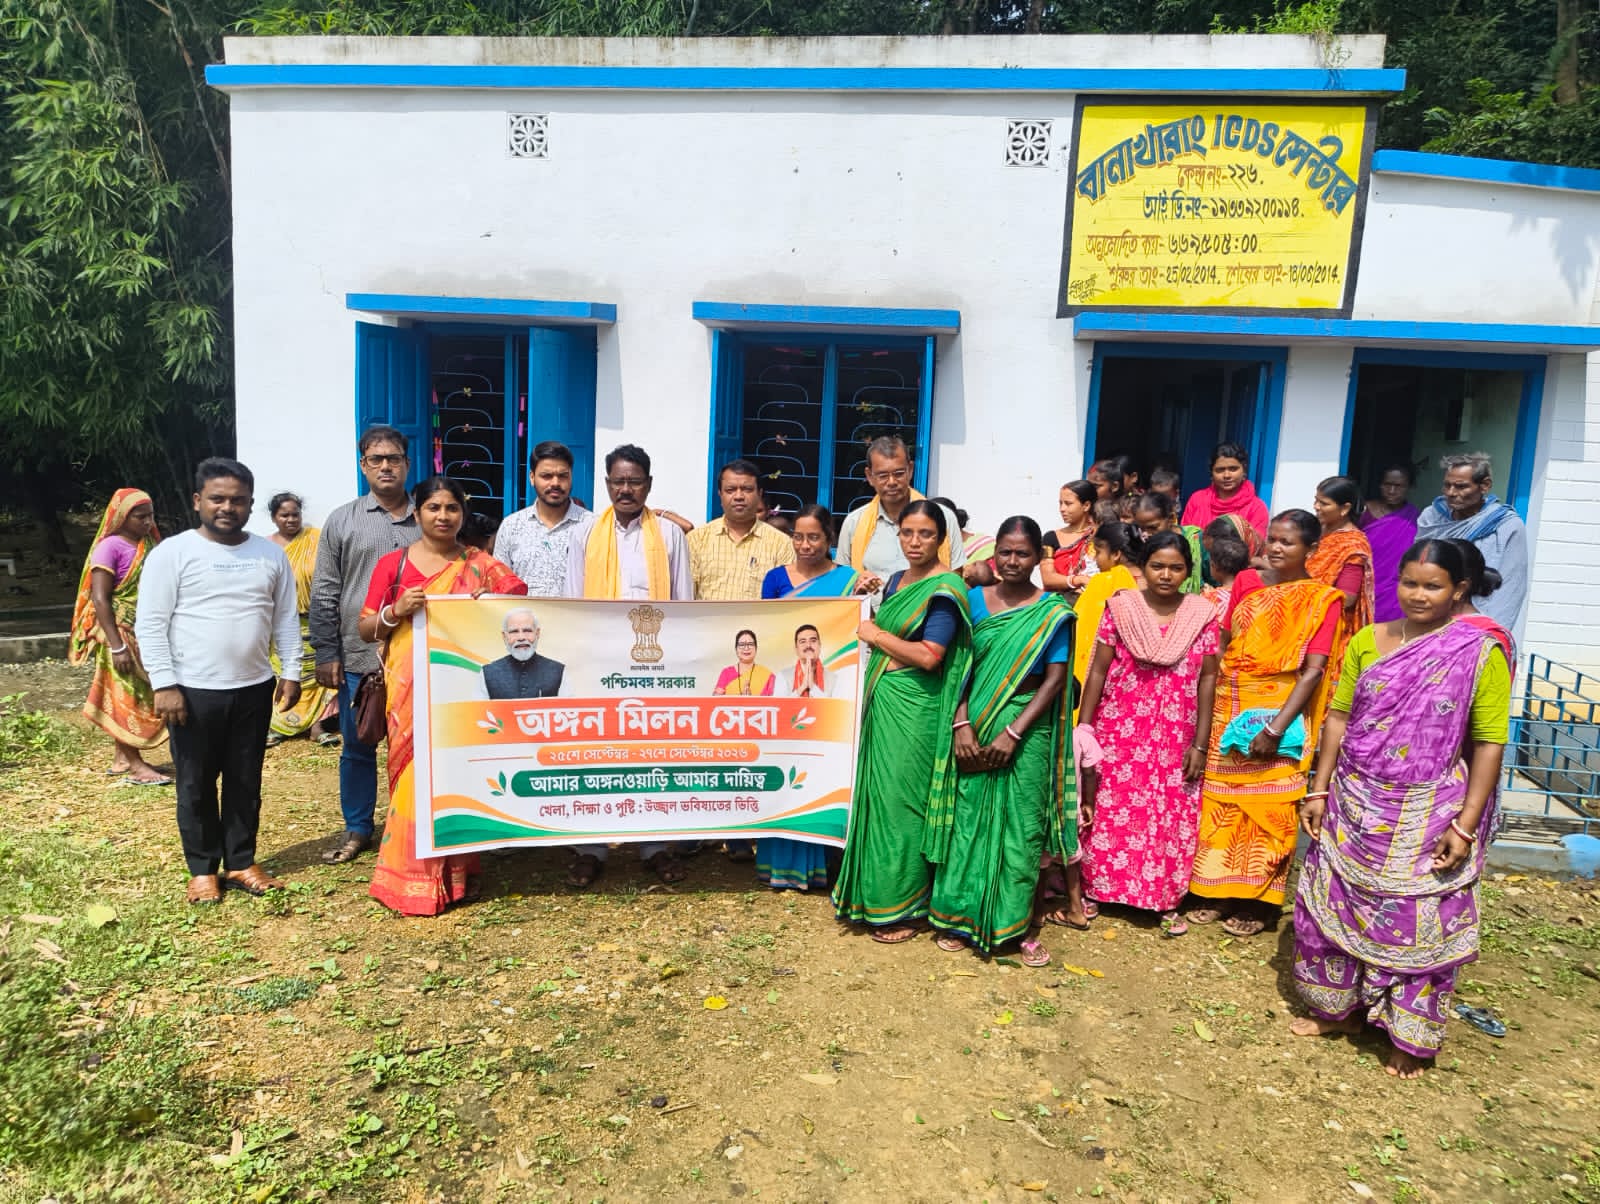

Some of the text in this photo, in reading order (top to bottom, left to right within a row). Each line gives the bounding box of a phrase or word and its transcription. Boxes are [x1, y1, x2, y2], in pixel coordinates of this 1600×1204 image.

[1076, 114, 1358, 219] বানাখারাং ICDS সেন্টার
[600, 672, 696, 689] পশ্চিমবঙ্গ সরকার
[513, 699, 780, 738] অঙ্গন মিলন সেবা
[550, 750, 580, 761] ২৫শে
[583, 747, 629, 760] সেপ্টেম্বর
[639, 748, 666, 759] ২৭শে
[669, 745, 714, 759] সেপ্টেম্বর
[717, 750, 748, 758] ২০২৬
[529, 767, 767, 793] আমার অঙ্গনওয়াড়ি আমার দায়িত্ব
[540, 803, 570, 818] খেলা,
[572, 800, 600, 816] শিক্ষা
[603, 803, 612, 814] ও
[615, 798, 636, 817] পুষ্টি
[644, 799, 677, 814] উজ্জ্বল
[679, 796, 732, 813] ভবিষ্যতের
[734, 796, 760, 813] ভিত্তি
